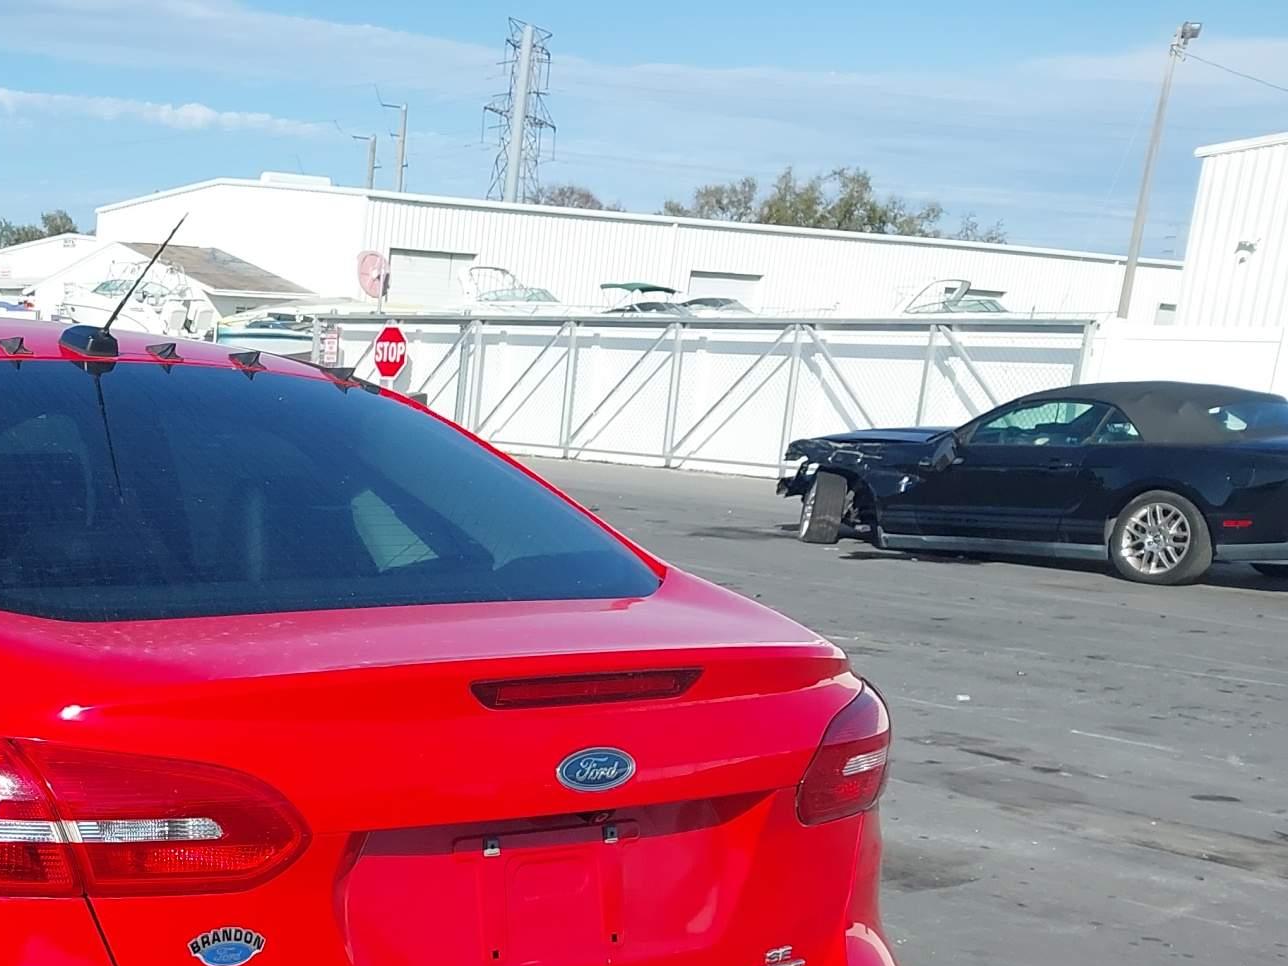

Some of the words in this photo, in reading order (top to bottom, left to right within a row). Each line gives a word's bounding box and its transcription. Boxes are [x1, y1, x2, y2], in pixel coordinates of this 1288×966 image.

[375, 341, 406, 363] STOP
[575, 756, 619, 782] Ford
[190, 928, 265, 954] BRANDON
[765, 945, 793, 964] SE
